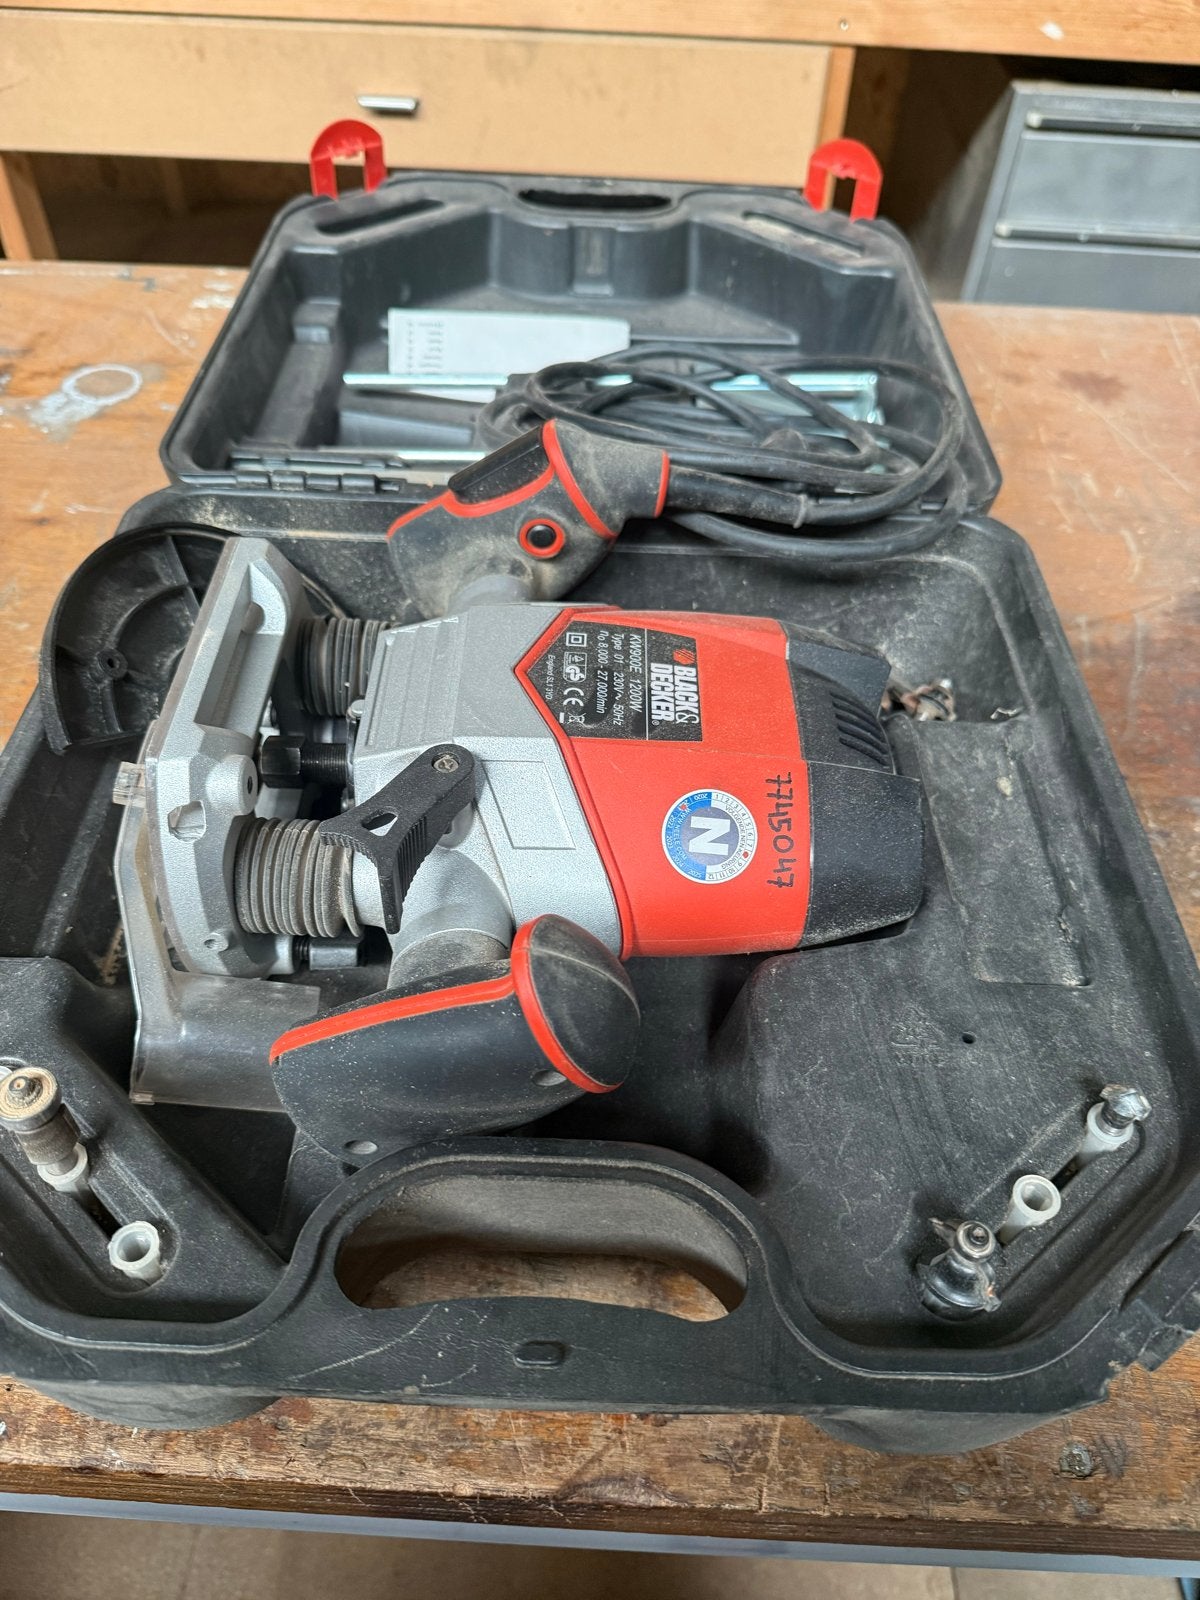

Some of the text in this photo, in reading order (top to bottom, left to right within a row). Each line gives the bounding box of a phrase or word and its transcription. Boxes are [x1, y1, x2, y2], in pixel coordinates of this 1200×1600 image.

[611, 633, 625, 650] Type
[546, 654, 556, 676] England
[614, 655, 624, 664] 01
[629, 633, 643, 713] KW900E 1200W
[613, 704, 624, 726] 50Hz
[688, 815, 731, 856] N
